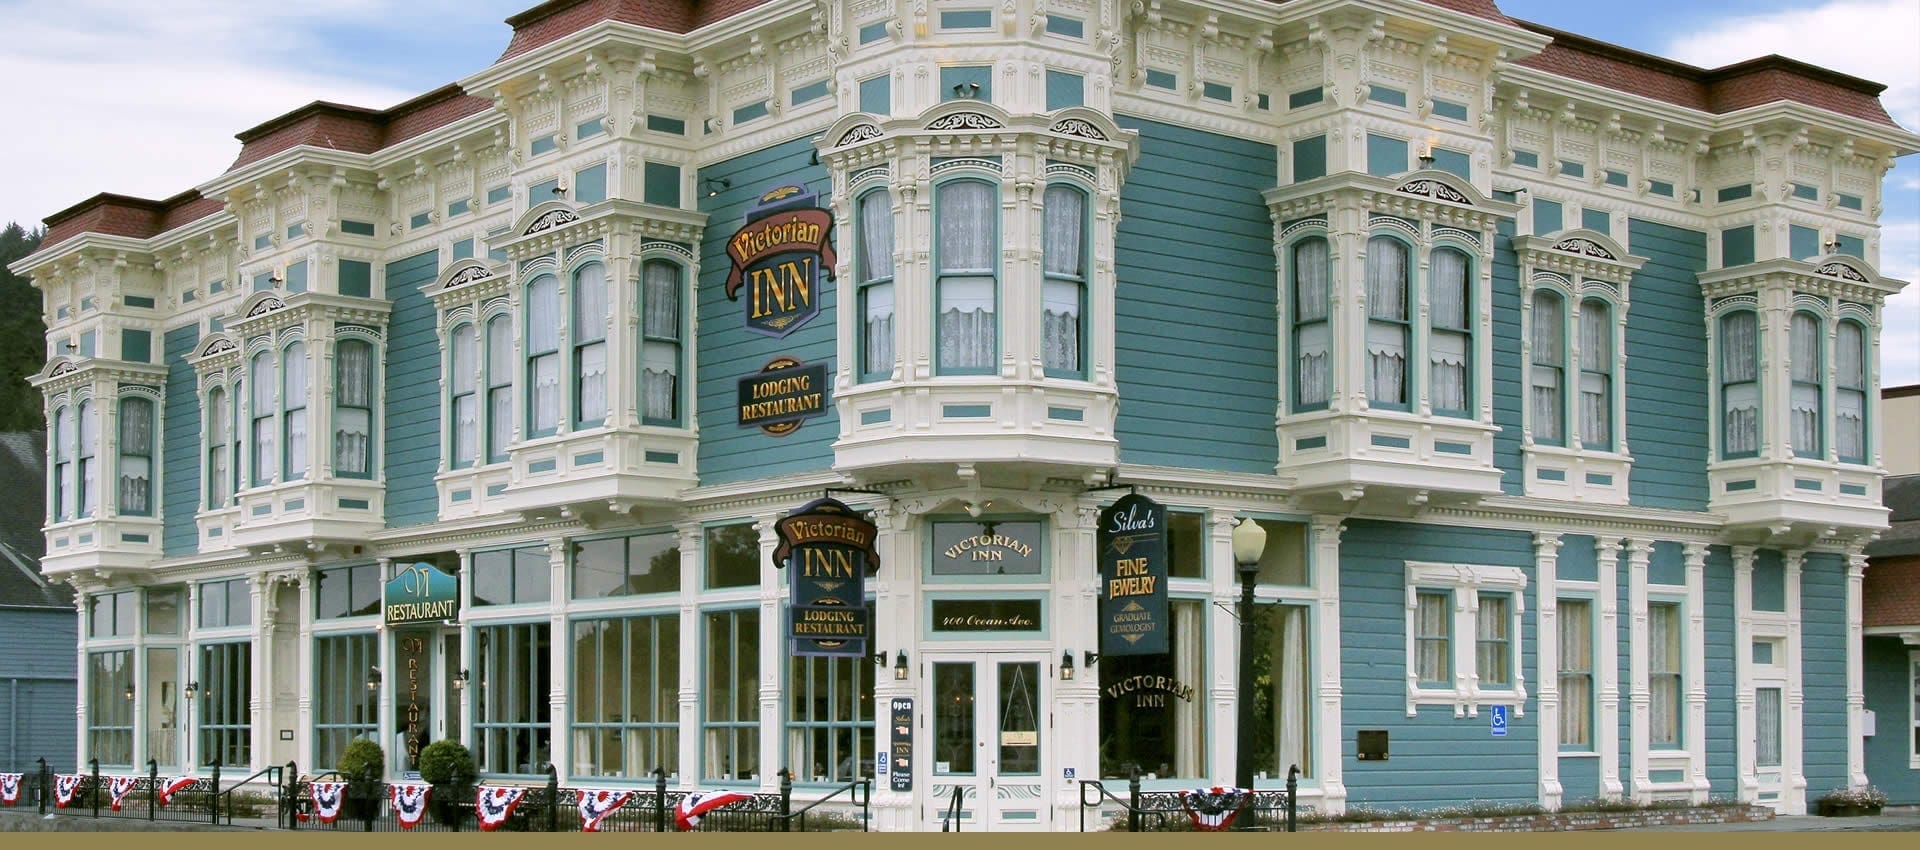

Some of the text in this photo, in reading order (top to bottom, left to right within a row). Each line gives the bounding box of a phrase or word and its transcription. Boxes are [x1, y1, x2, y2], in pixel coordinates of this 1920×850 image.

[733, 216, 821, 263] Victorian
[751, 258, 811, 319] INN
[753, 375, 810, 399] LODGING
[742, 393, 822, 420] RESTAURANT
[1109, 503, 1155, 533] Silva's
[788, 520, 866, 545] Victorian
[944, 534, 1033, 559] VICTORIAN
[972, 550, 1003, 561] INN
[803, 547, 854, 578] INN
[1117, 557, 1149, 577] FINE
[1109, 576, 1156, 600] JEWELRY
[387, 599, 454, 621] RESTAURANT
[804, 610, 854, 621] LODGING
[943, 616, 964, 626] 400
[967, 615, 1002, 626] Ocean
[1113, 612, 1152, 623] GRADUATE
[795, 623, 864, 635] RESTAURANT
[1110, 622, 1156, 634] GEMOLOGIST
[1107, 675, 1194, 703] VICTORIAN
[1136, 694, 1165, 708] INN
[408, 658, 420, 766] RESTAURANT
